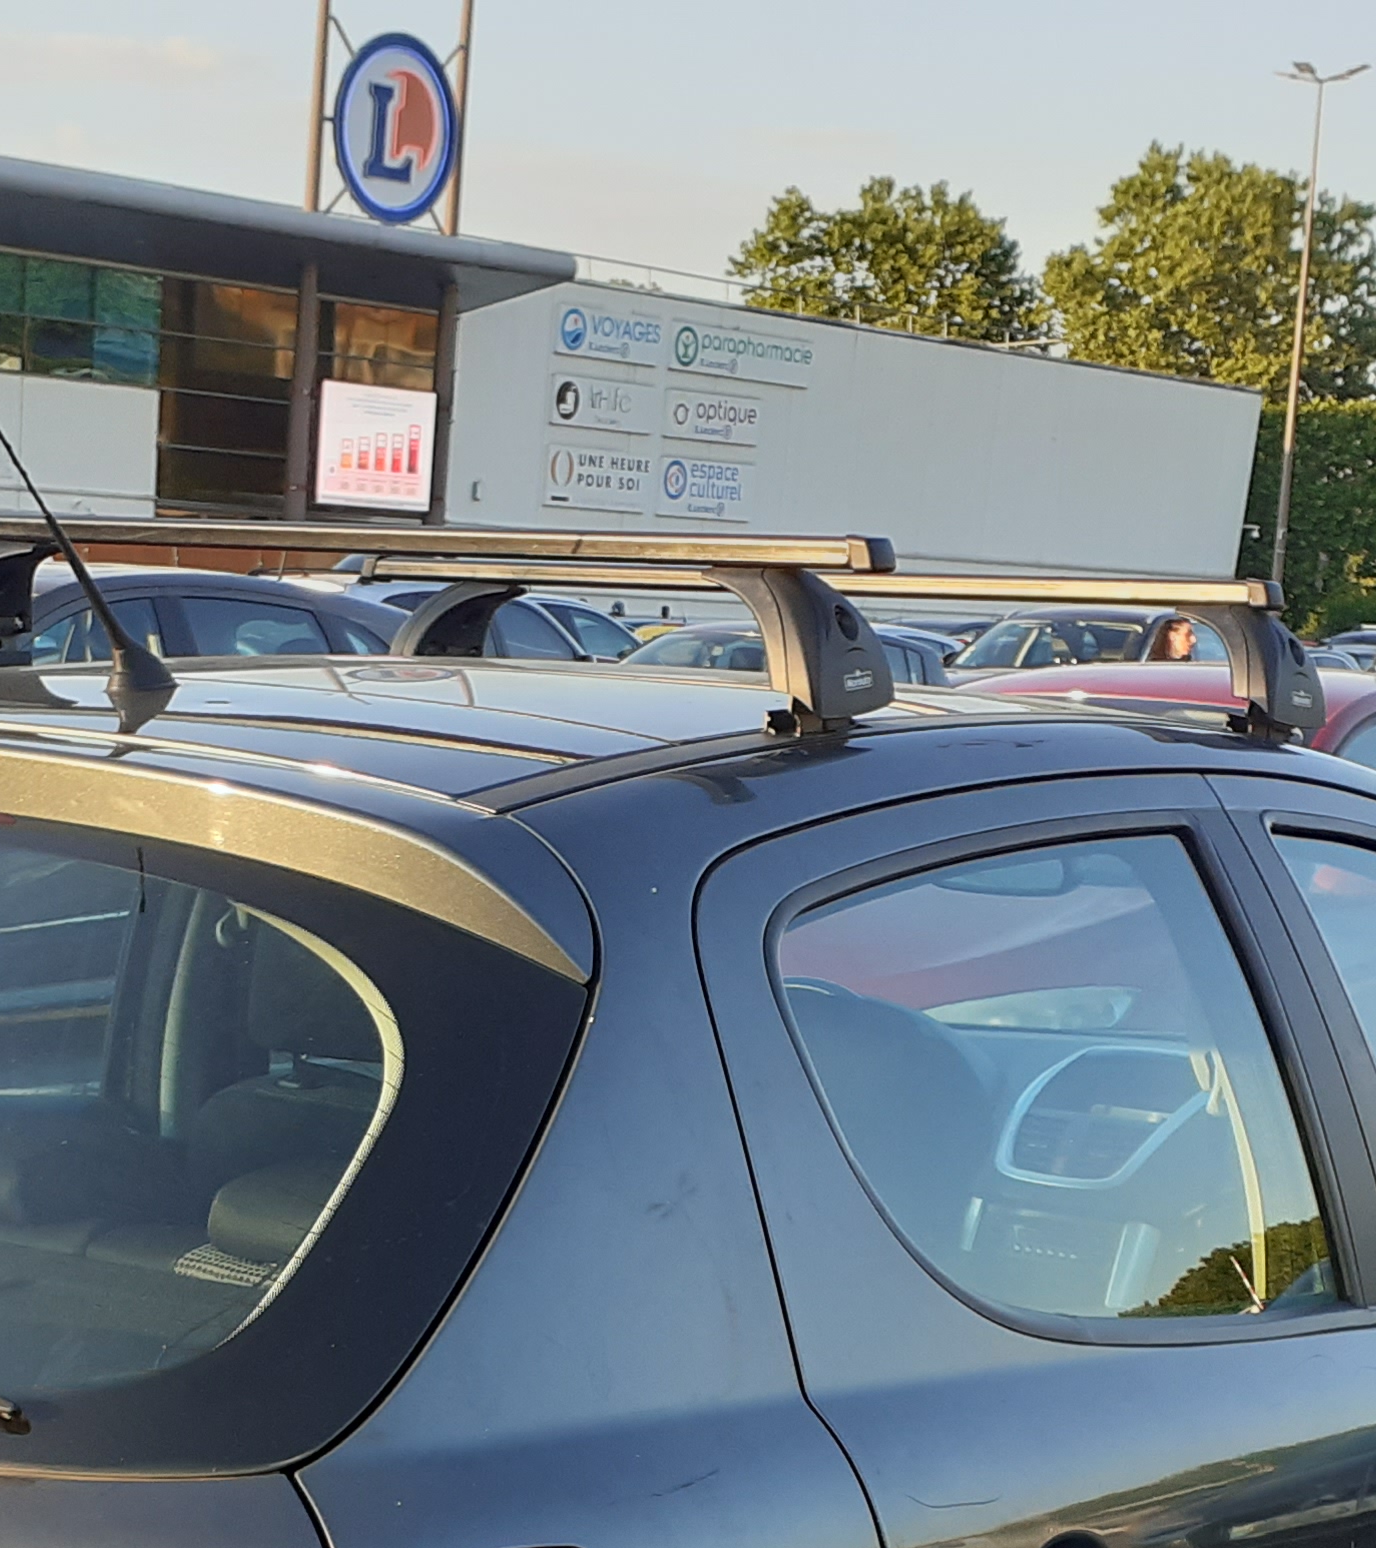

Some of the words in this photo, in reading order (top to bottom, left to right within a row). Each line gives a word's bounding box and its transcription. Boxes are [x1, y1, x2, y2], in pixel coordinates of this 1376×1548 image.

[363, 81, 414, 184] L
[591, 315, 662, 344] VOYAGES
[700, 332, 814, 365] parapharmacie
[696, 401, 758, 427] optique
[578, 454, 605, 469] UNE
[610, 456, 651, 474] HEURE
[690, 463, 740, 481] espace
[577, 473, 612, 490] POUR
[618, 478, 641, 492] SOI
[689, 481, 742, 502] culturel
